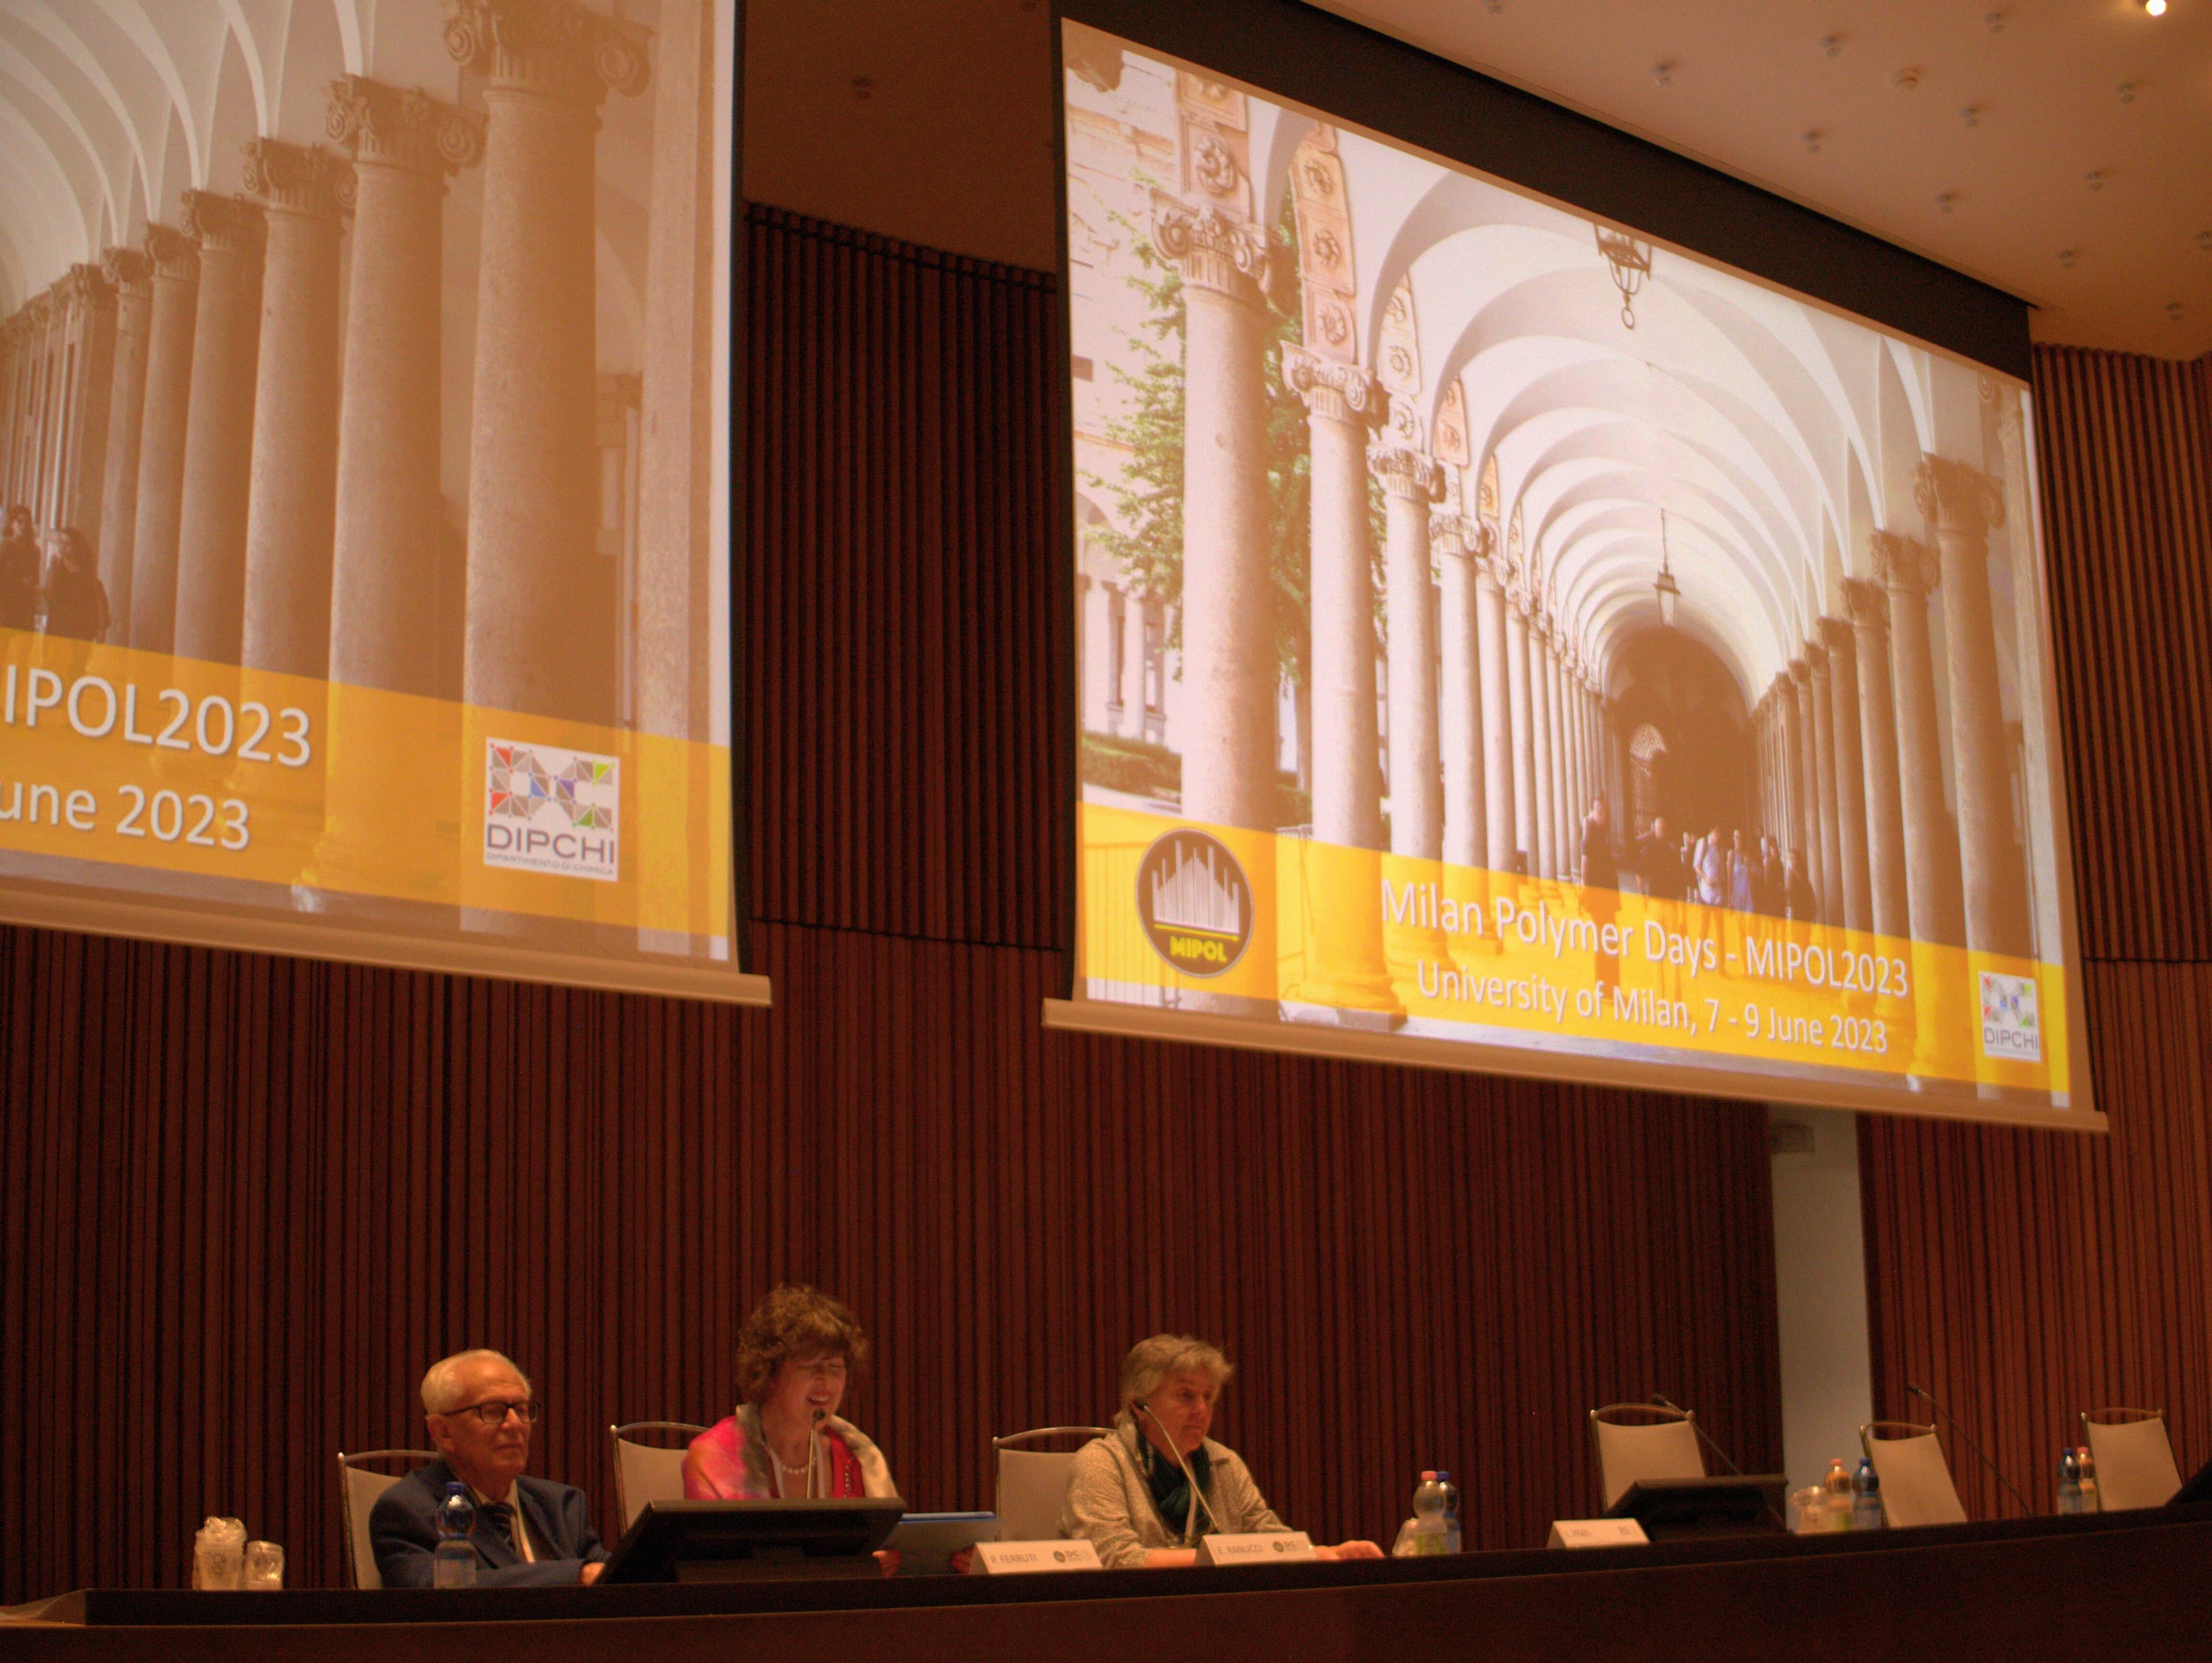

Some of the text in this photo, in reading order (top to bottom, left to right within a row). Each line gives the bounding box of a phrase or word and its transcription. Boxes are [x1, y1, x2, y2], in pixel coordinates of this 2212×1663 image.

[116, 785, 249, 850] 2023
[486, 823, 615, 864] DIPCHI
[1169, 936, 1228, 963] MIPOL
[1382, 879, 1483, 935] Milan
[1496, 896, 1634, 958] Polymer
[1645, 919, 1717, 978] Days
[1745, 935, 1908, 998] MIPOL2023
[1418, 959, 1567, 1023] University
[1575, 980, 1604, 1018] of
[1613, 985, 1698, 1037] Milan,
[1705, 998, 1720, 1032] 7
[1744, 1003, 1760, 1038] 9
[1767, 1007, 1823, 1047] June
[1830, 1014, 1888, 1054] 2023
[1984, 1027, 2038, 1050] DIPCHI
